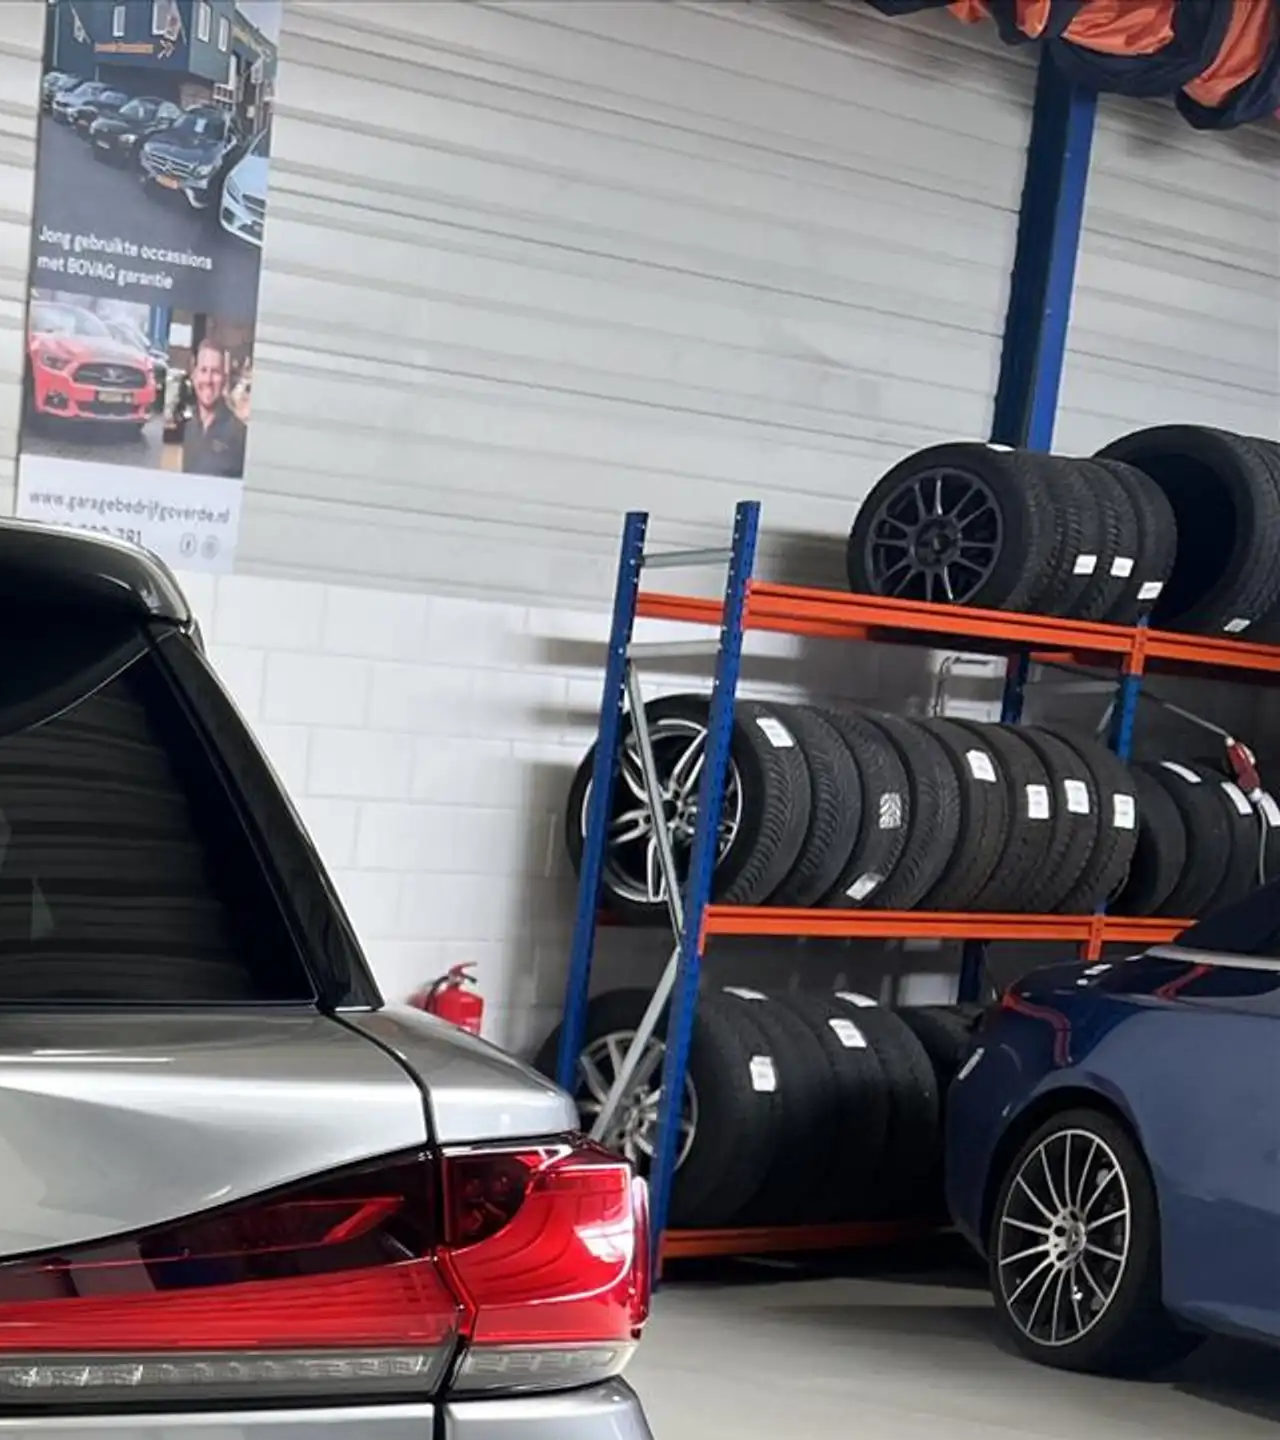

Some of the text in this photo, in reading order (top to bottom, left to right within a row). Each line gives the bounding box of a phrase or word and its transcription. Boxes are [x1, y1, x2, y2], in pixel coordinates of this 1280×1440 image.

[39, 225, 71, 250] Jong
[74, 233, 138, 257] gebruikte
[37, 256, 173, 288] met BOVAG garantie
[29, 491, 230, 524] www.garagebedrijfgoverde.nl
